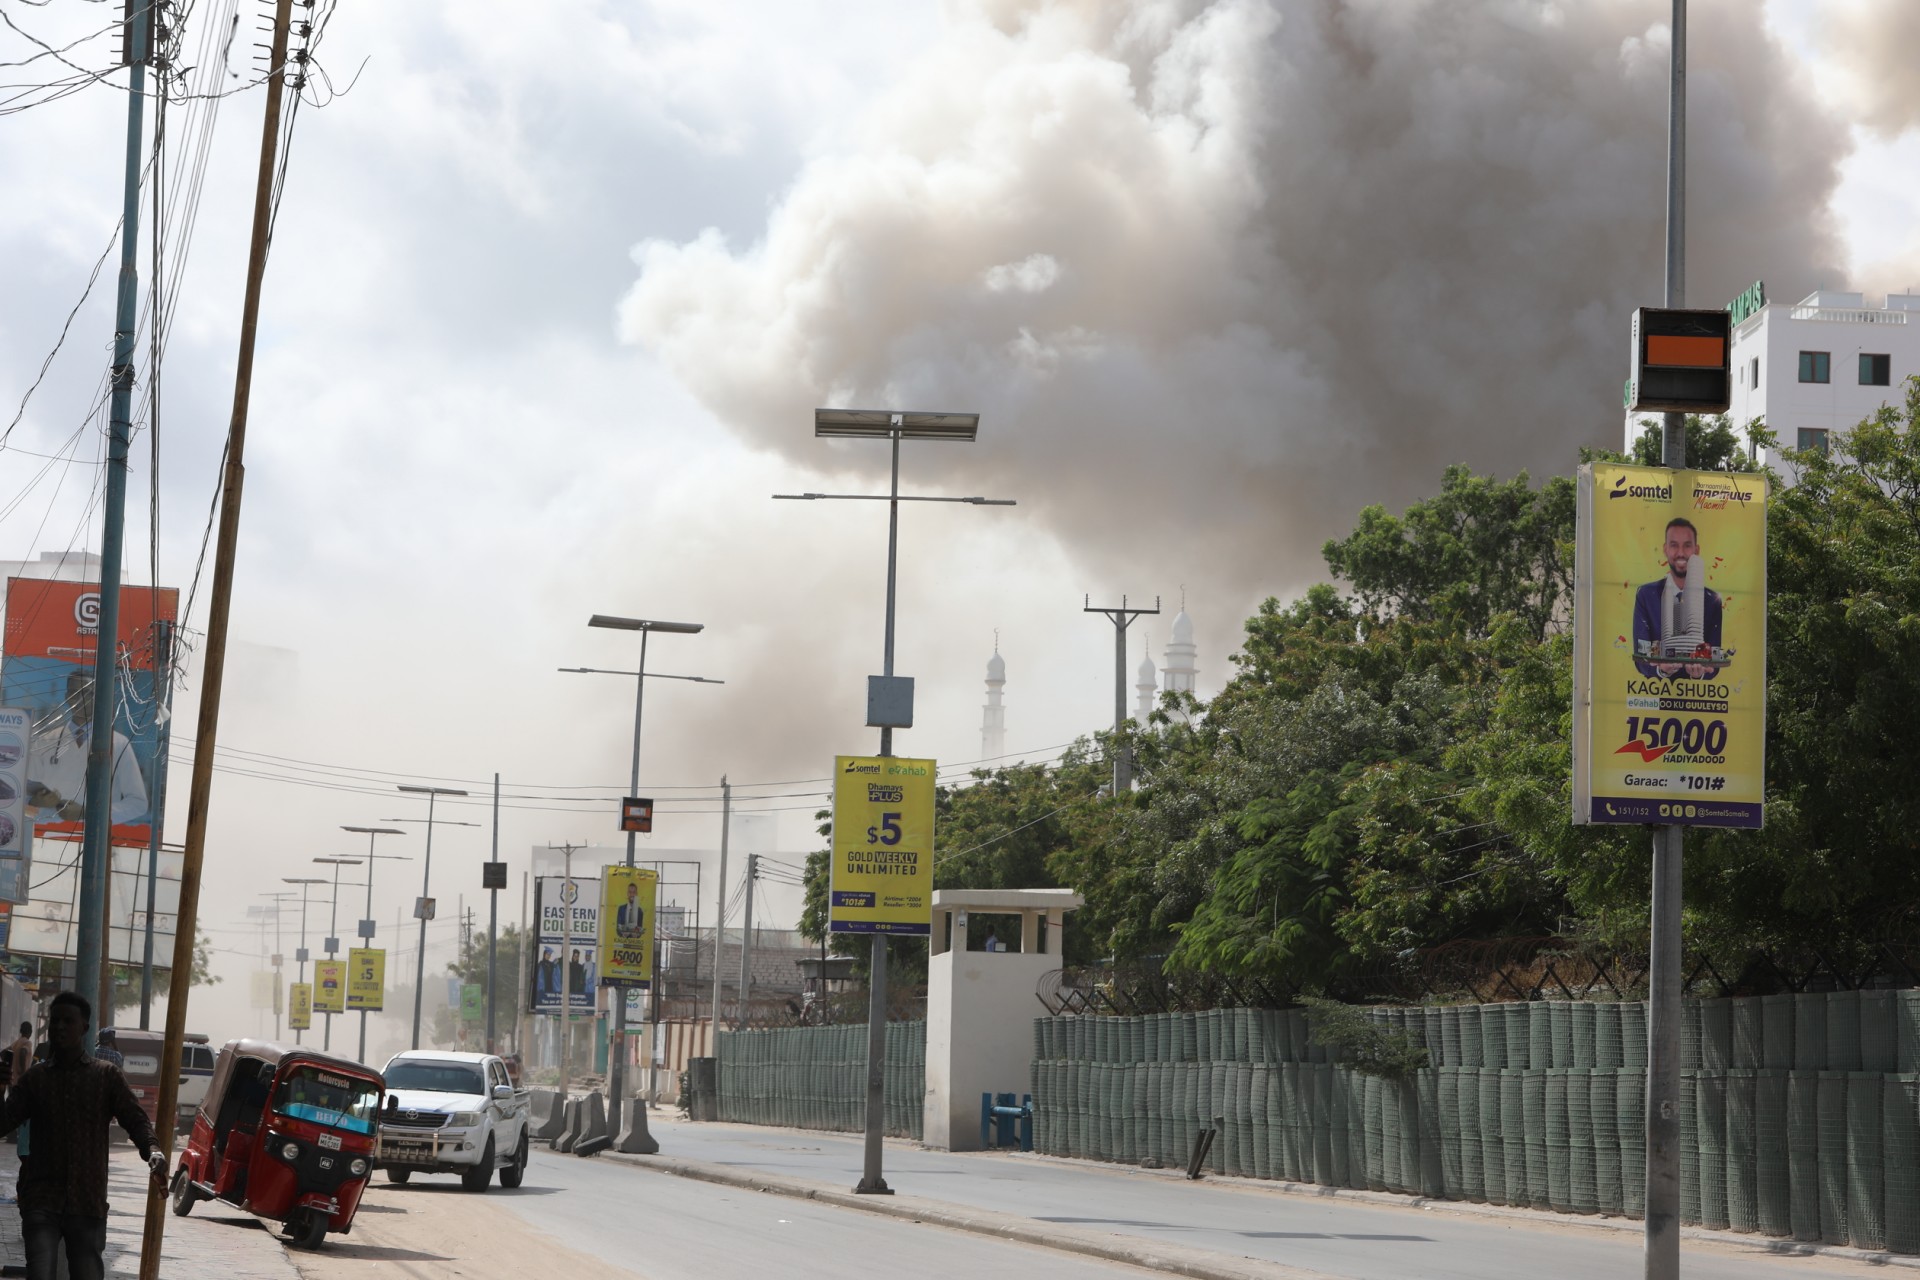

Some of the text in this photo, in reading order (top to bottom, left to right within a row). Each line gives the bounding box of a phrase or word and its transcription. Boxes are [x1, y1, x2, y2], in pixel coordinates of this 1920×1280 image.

[1727, 280, 1761, 328] AMPUS
[1629, 484, 1672, 500] somtel
[1627, 680, 1729, 698] KAGA SHUBO
[1686, 702, 1727, 710] GUULEYSO
[1626, 716, 1727, 755] 15000
[1663, 755, 1725, 764] HADIYADOOD
[868, 783, 903, 791] Dhamays
[1624, 775, 1668, 787] Garaac:
[1619, 807, 1648, 816] 151/152
[1697, 808, 1749, 818] @SomtelSomalia
[867, 812, 901, 845] $5
[848, 852, 916, 864] GOLD WEEKLY
[848, 864, 916, 875] UNLIMITED
[544, 907, 596, 919] EASERN
[544, 920, 595, 932] COLEGE
[613, 950, 642, 964] 15000
[316, 1111, 348, 1126] BELCO
